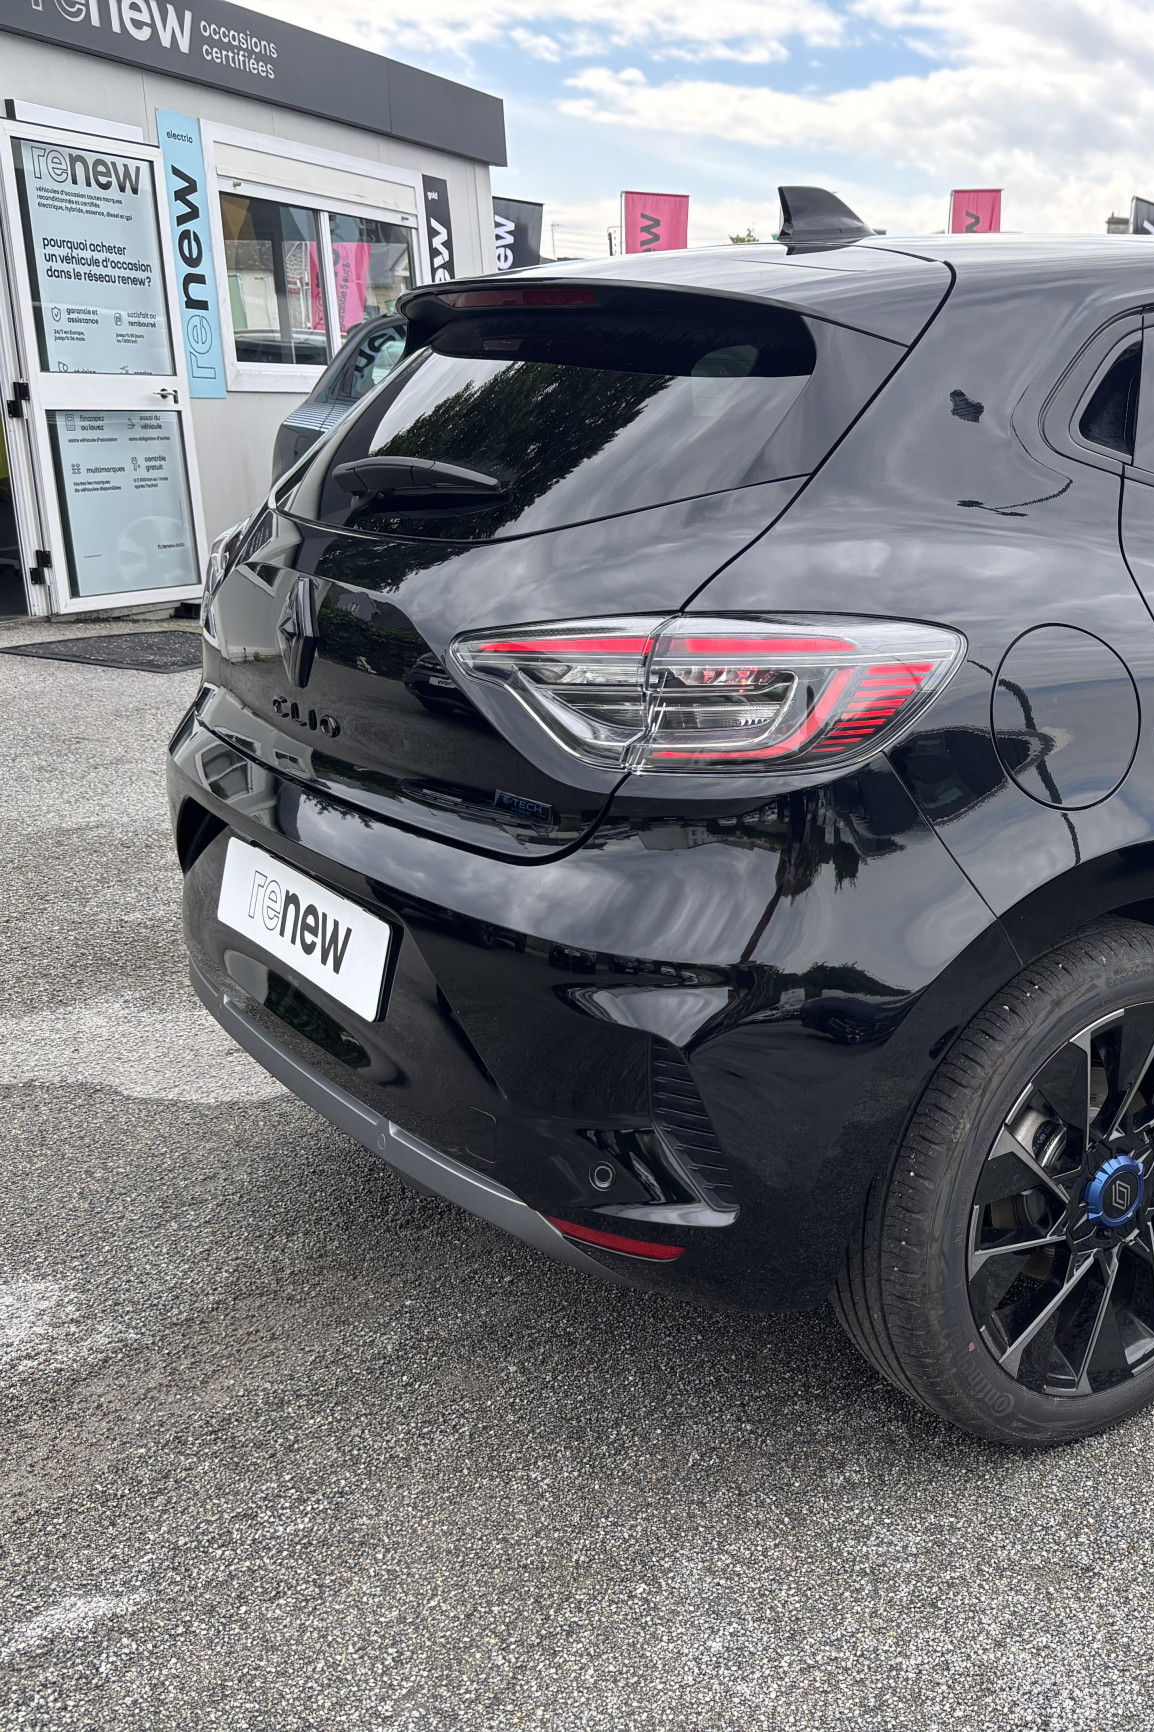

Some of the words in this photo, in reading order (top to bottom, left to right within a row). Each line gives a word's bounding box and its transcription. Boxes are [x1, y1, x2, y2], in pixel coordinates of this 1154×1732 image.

[200, 20, 278, 58] occasions
[202, 44, 275, 79] certifiées
[166, 130, 194, 144] electric
[31, 146, 140, 195] renew
[42, 236, 88, 252] pourquoi
[89, 241, 126, 256] acheter
[44, 252, 57, 264] un
[58, 251, 100, 268] véhicule
[102, 256, 152, 273] d'occasion
[170, 164, 217, 379] renew
[46, 266, 72, 280] dans
[73, 268, 82, 278] le
[83, 269, 117, 284] réseau
[66, 307, 91, 316] garantie
[67, 316, 99, 325] assistance
[144, 454, 166, 463] contrôle
[145, 464, 164, 472] gratuit
[86, 465, 125, 474] multimarques
[272, 695, 341, 738] CLIO
[247, 869, 353, 976] renew
